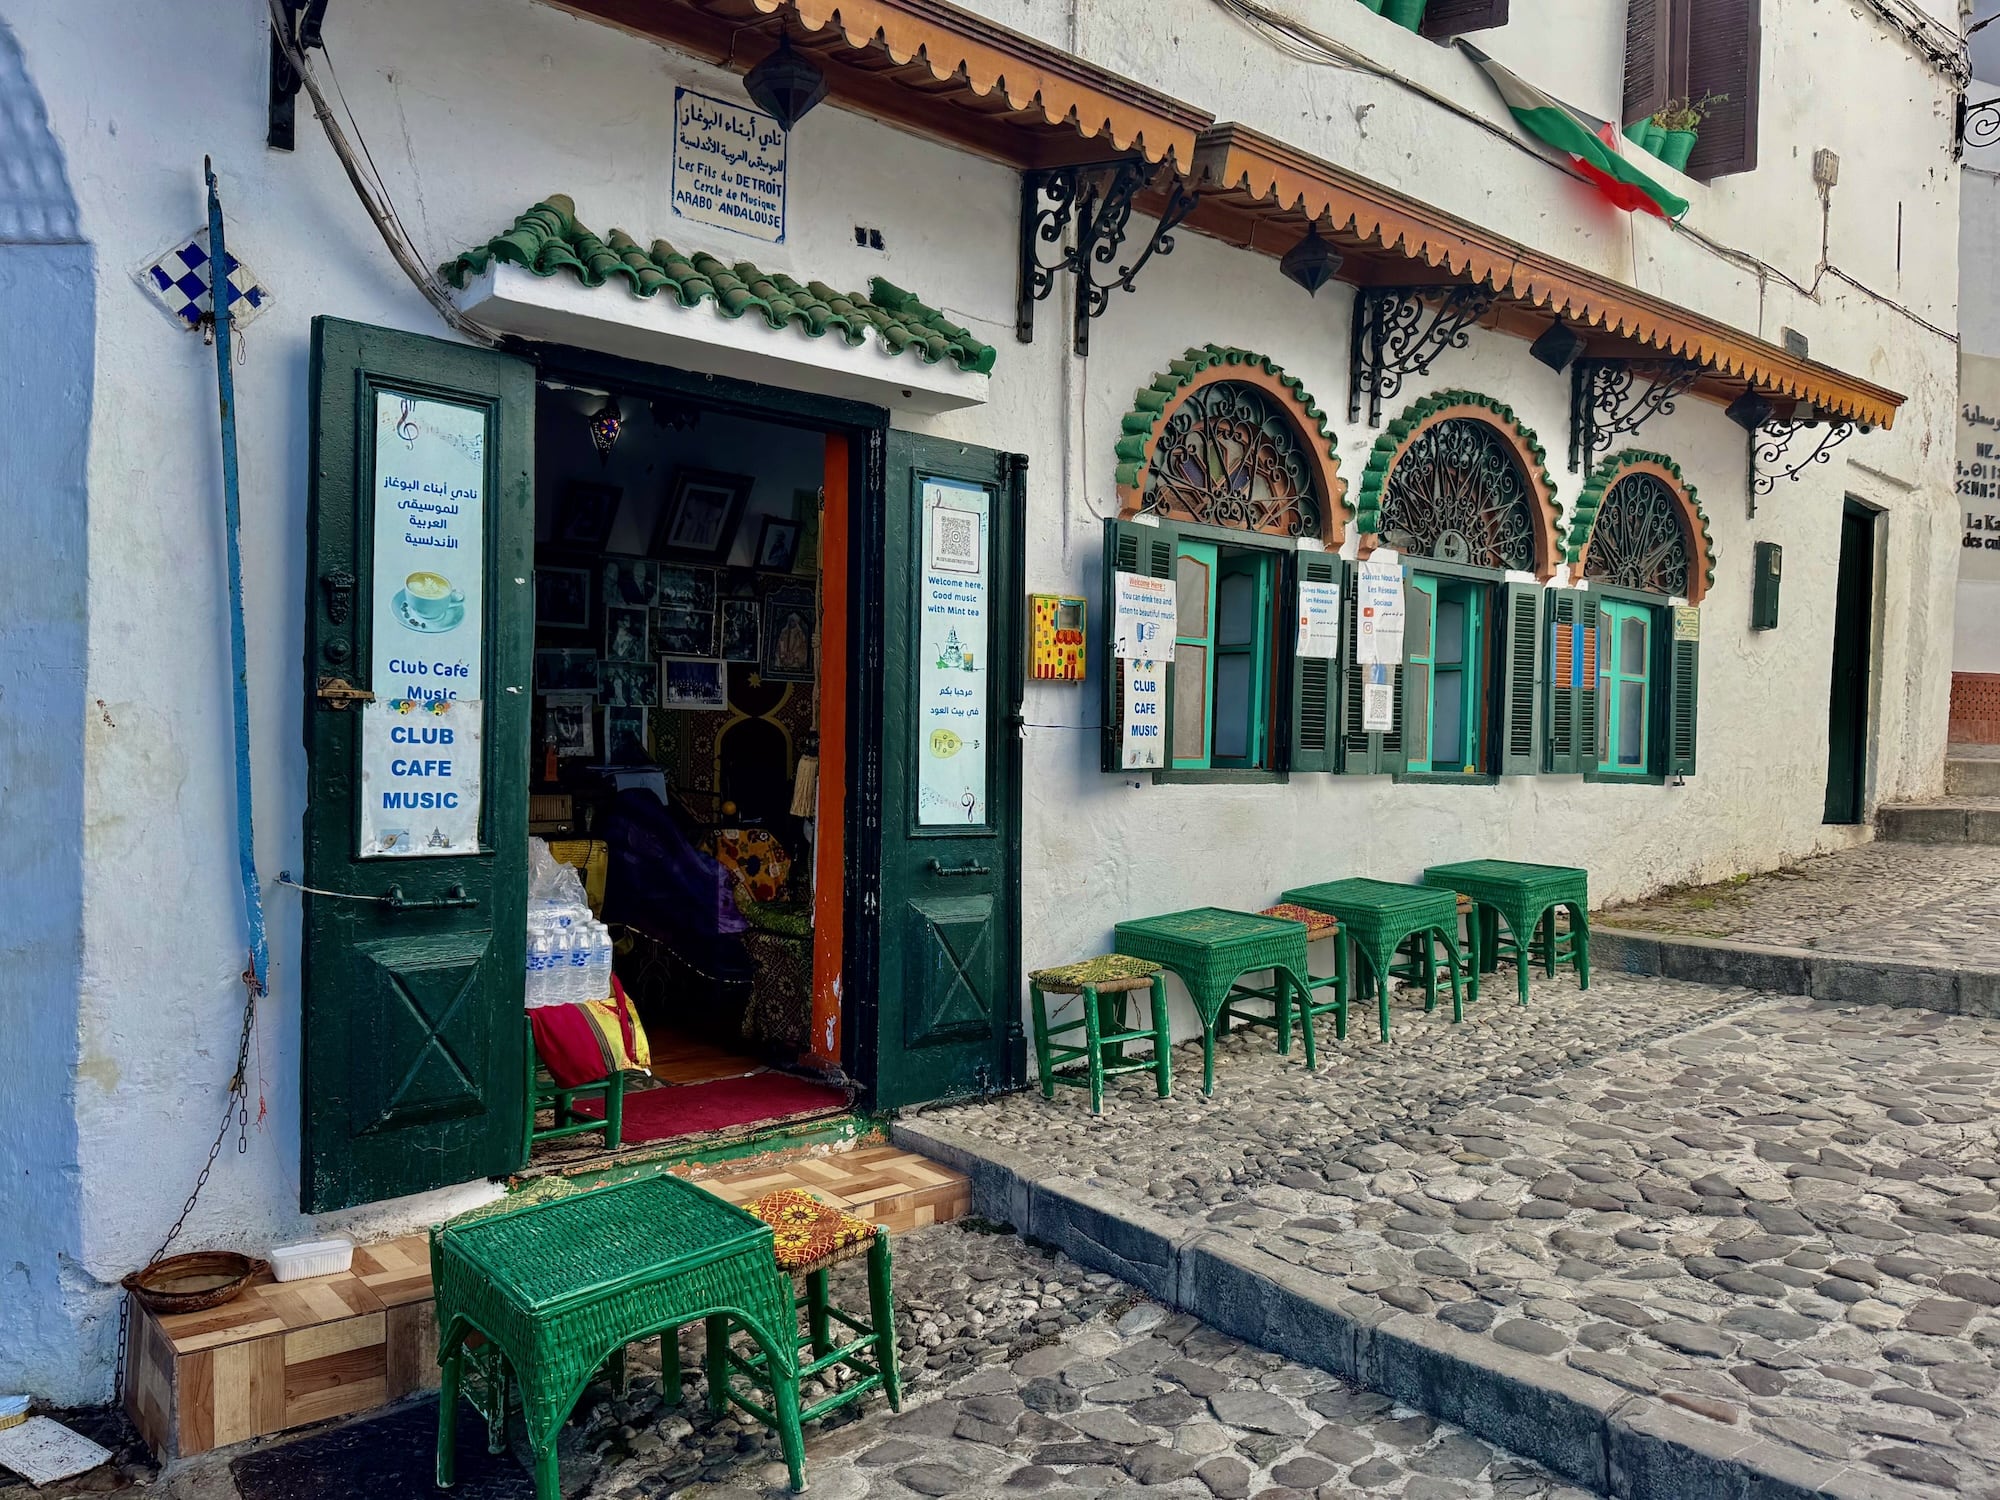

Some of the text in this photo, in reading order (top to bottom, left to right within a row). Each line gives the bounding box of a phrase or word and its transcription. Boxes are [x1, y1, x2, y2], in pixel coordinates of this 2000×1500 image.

[681, 104, 782, 152] نادي أبناء البوغاز
[680, 132, 720, 154] الأندلسية
[721, 145, 748, 165] العربية
[678, 156, 695, 173] Les
[697, 162, 717, 179] Fils
[721, 170, 733, 183] du
[694, 179, 777, 212] Cercle de Musique
[676, 189, 781, 229] ARABO ANDALOUSE
[384, 476, 478, 501] نادي أبناء البوغاز
[397, 498, 459, 515] للموسيقى
[409, 514, 448, 530] العربية
[1966, 512, 1983, 530] La
[405, 532, 459, 550] الأندلسية
[1962, 531, 1983, 548] des
[928, 575, 963, 588] Welcome
[1129, 576, 1150, 588] Welcome
[932, 590, 977, 603] Good music
[1122, 591, 1172, 606] You can drink tea and
[928, 604, 980, 617] with Mint tea
[1119, 604, 1134, 615] listen
[389, 659, 428, 675] Club
[407, 684, 457, 700] Music
[939, 685, 974, 697] مرحبا بكم
[1133, 679, 1156, 692] CLUB
[930, 705, 949, 716] العود
[951, 706, 965, 717] بيت
[1134, 702, 1156, 715] CAFE
[390, 726, 454, 744] CLUB
[1131, 724, 1158, 737] MUSIC
[391, 759, 452, 777] CAFE
[383, 792, 459, 809] MUSIC
